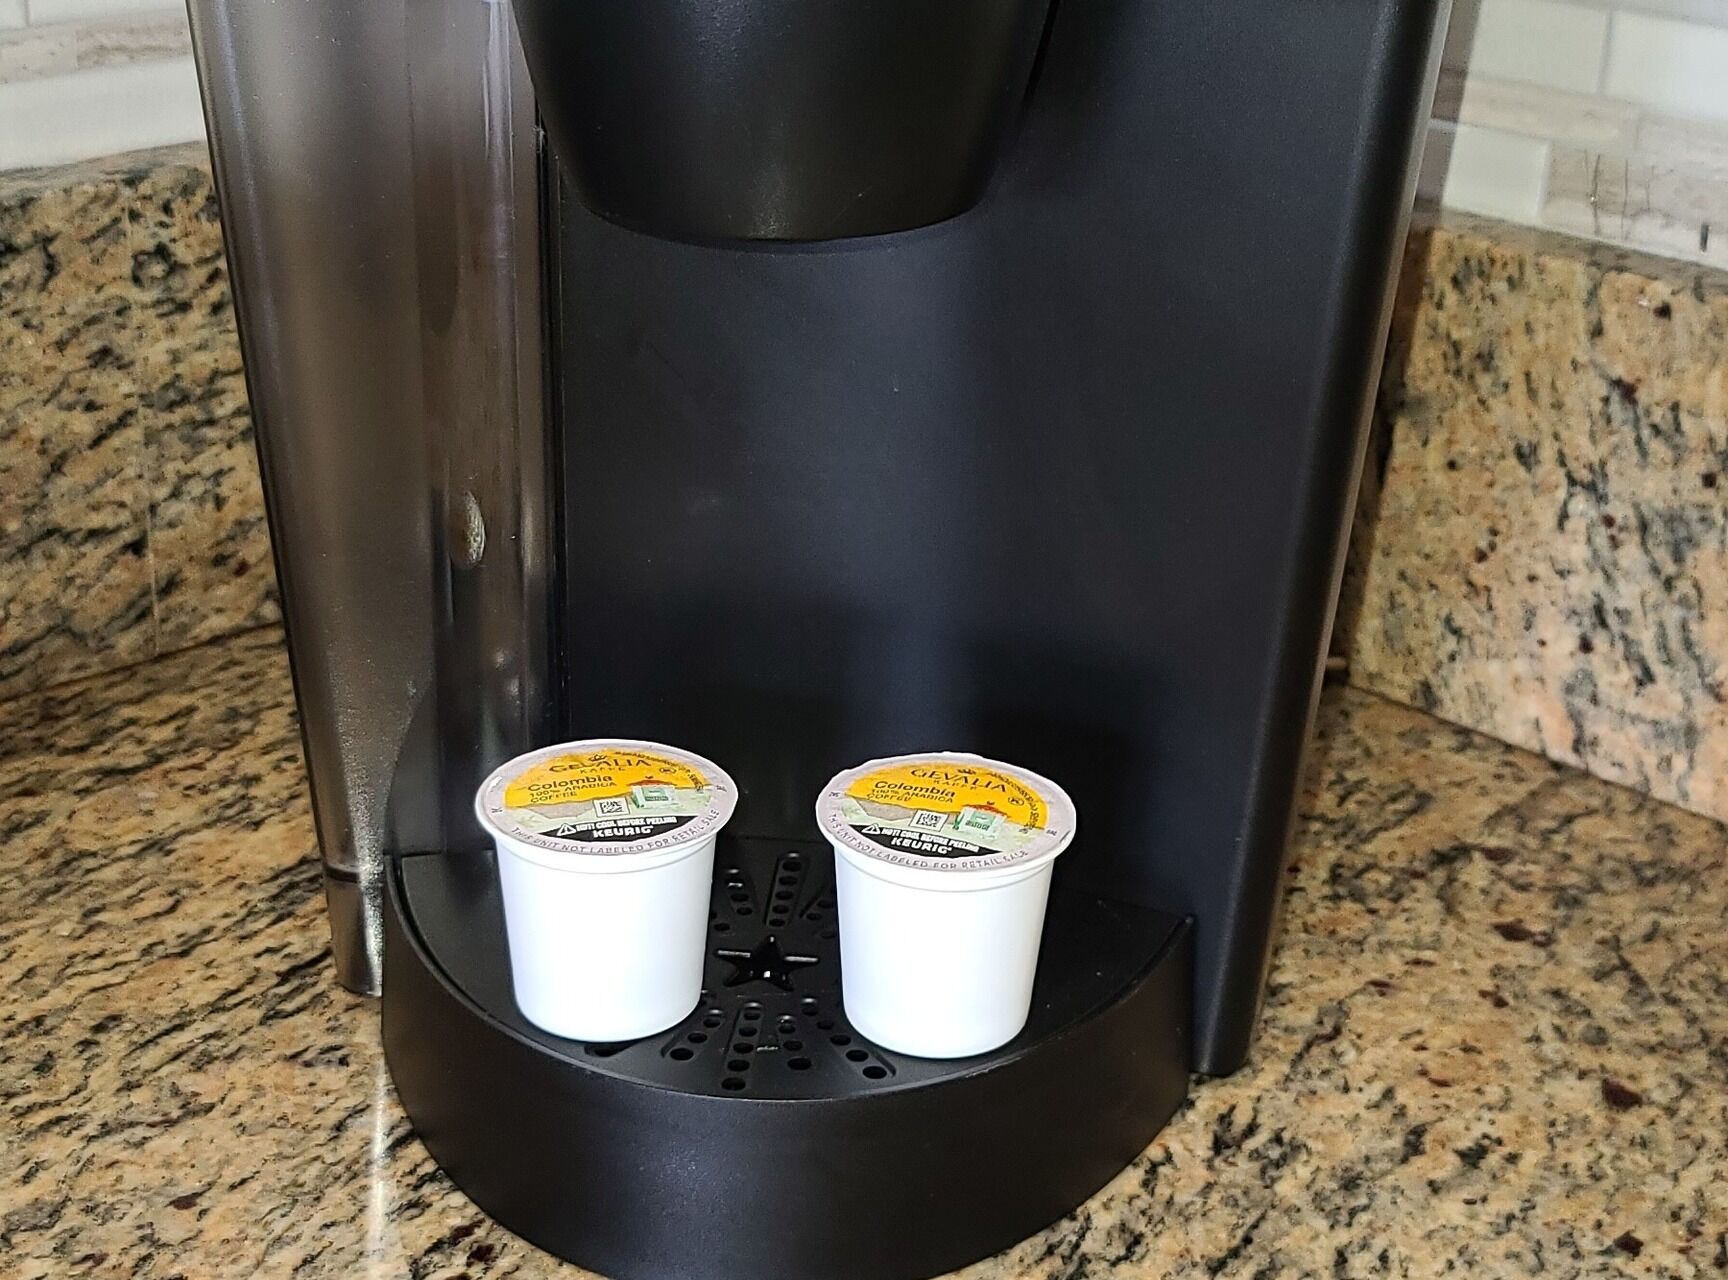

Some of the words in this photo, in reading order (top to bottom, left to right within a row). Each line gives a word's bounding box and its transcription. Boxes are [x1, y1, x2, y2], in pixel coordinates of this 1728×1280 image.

[527, 775, 613, 792] Colombia
[910, 768, 1007, 793] GEVALIA
[530, 789, 561, 798] 100%
[874, 781, 956, 798] Colombia
[561, 844, 585, 853] NOT
[647, 837, 671, 849] FOR
[891, 837, 950, 854] KEURIG
[877, 850, 929, 868] LABELED
[933, 861, 957, 869] FOR
[962, 858, 1002, 869] RETAIL
